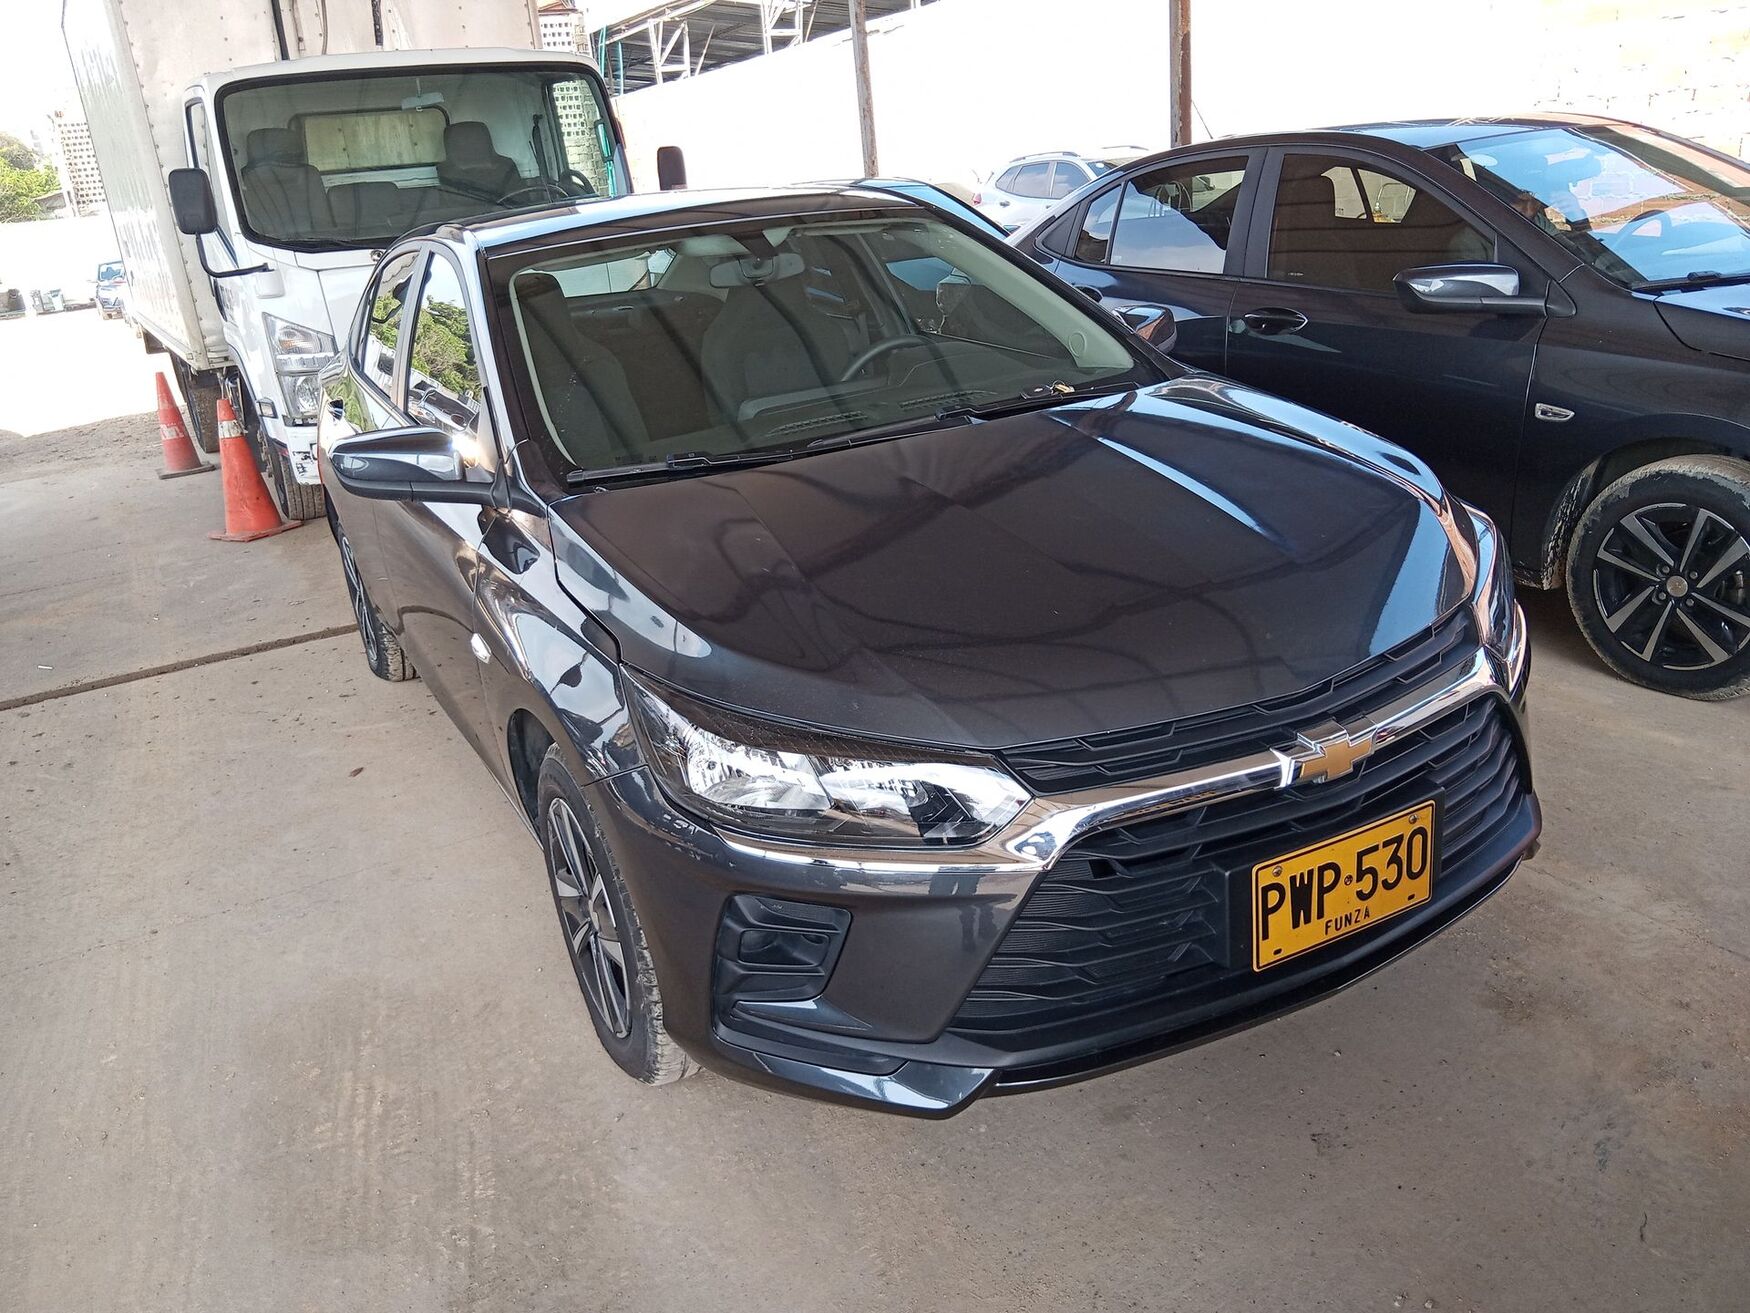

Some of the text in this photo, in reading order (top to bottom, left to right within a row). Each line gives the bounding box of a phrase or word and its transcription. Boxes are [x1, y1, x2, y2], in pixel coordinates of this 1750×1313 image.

[1261, 826, 1428, 941] PWP 530
[1325, 906, 1370, 936] FUNZA
